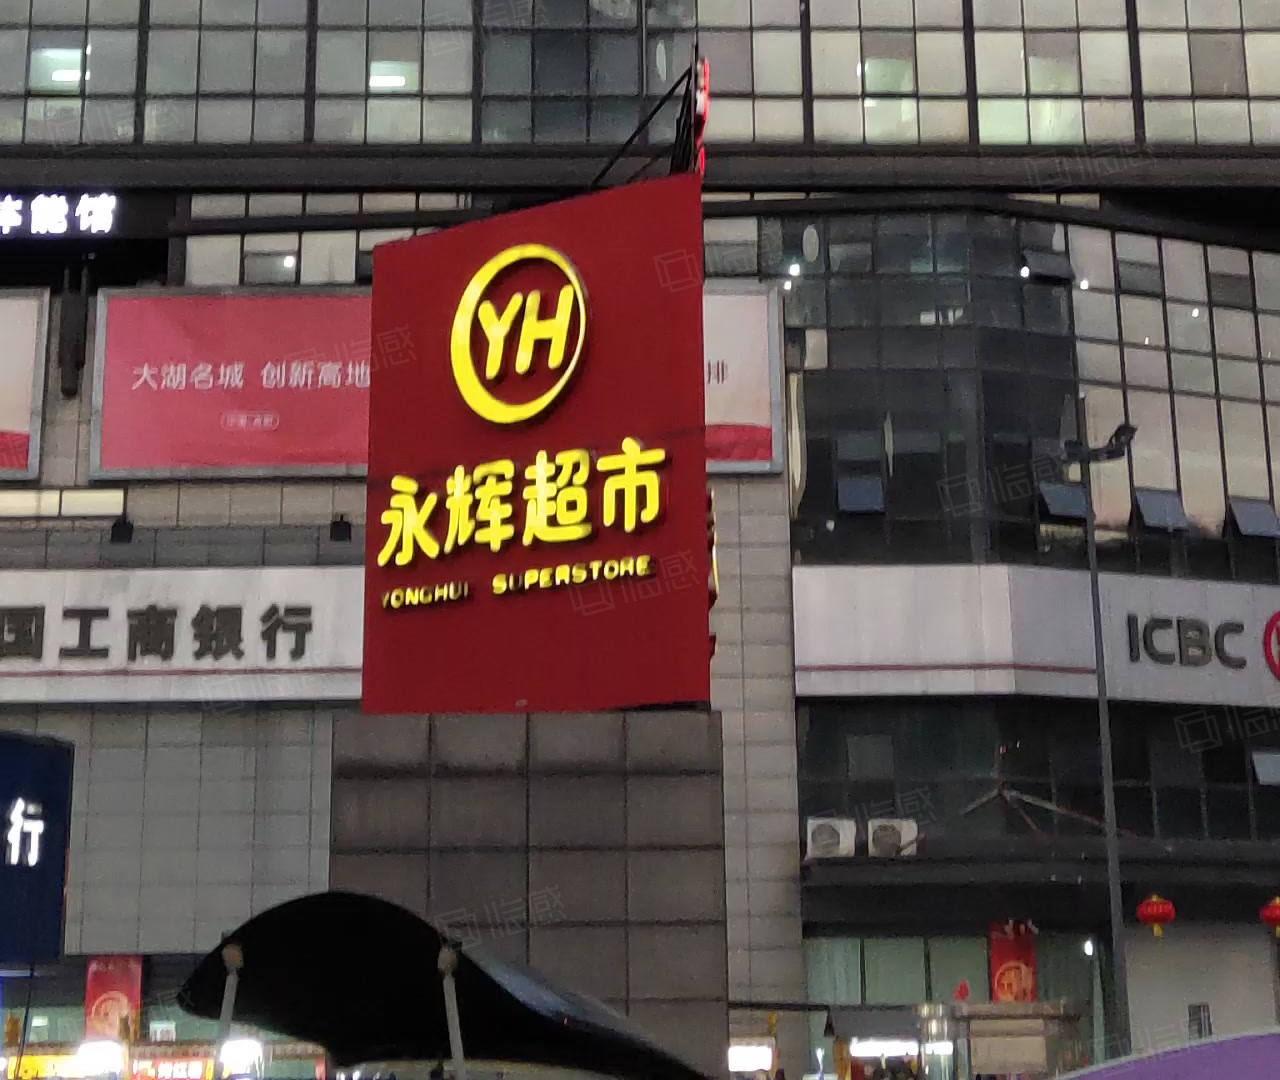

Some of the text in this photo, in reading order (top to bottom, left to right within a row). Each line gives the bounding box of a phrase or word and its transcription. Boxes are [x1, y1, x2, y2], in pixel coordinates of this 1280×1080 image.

[477, 283, 575, 381] YH
[131, 360, 245, 391] 大湖名城
[376, 436, 666, 568] 永辉超市
[380, 554, 654, 611] YONGHUI SUPERSTORE
[1127, 613, 1248, 671] ICBC
